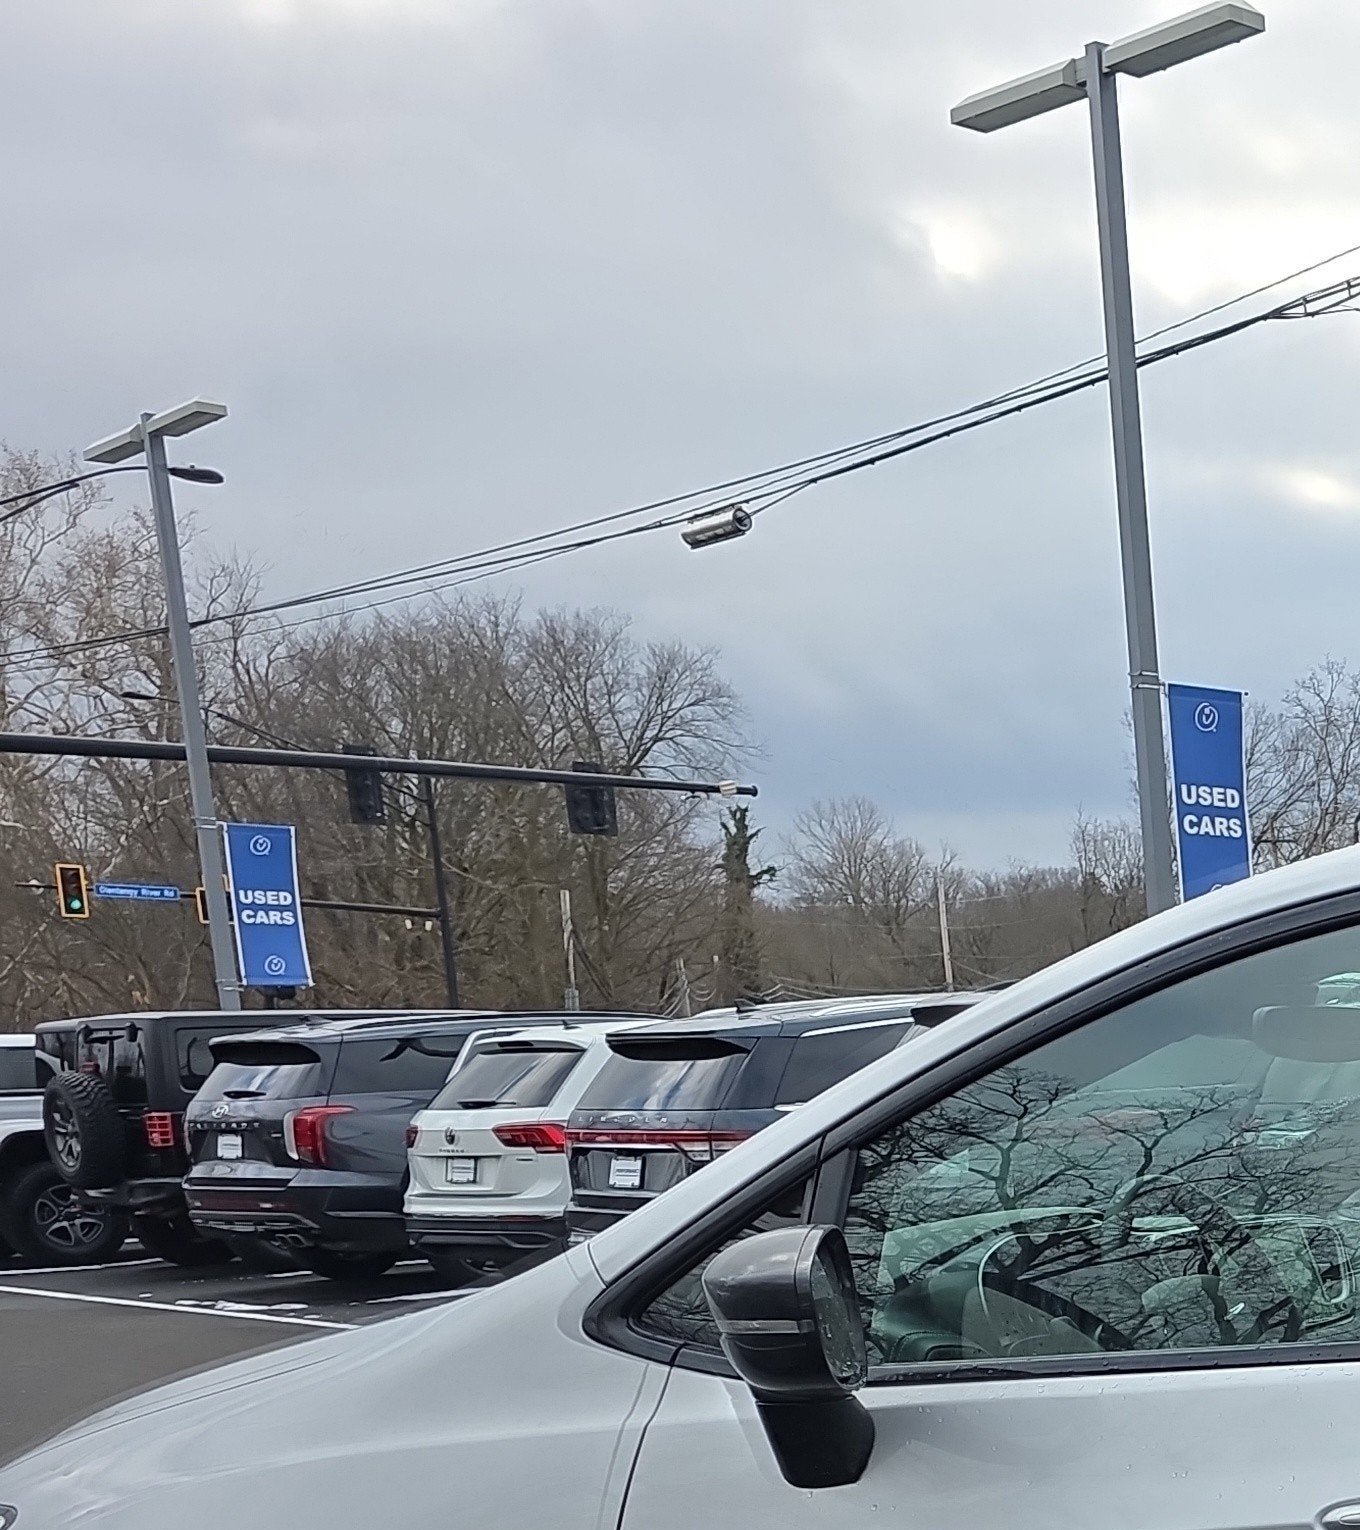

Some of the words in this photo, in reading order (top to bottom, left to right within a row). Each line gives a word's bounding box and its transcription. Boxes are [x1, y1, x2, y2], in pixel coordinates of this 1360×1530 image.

[1180, 784, 1240, 808] USED
[1183, 814, 1242, 838] CARS
[238, 889, 293, 906] USED
[241, 909, 296, 926] CARS
